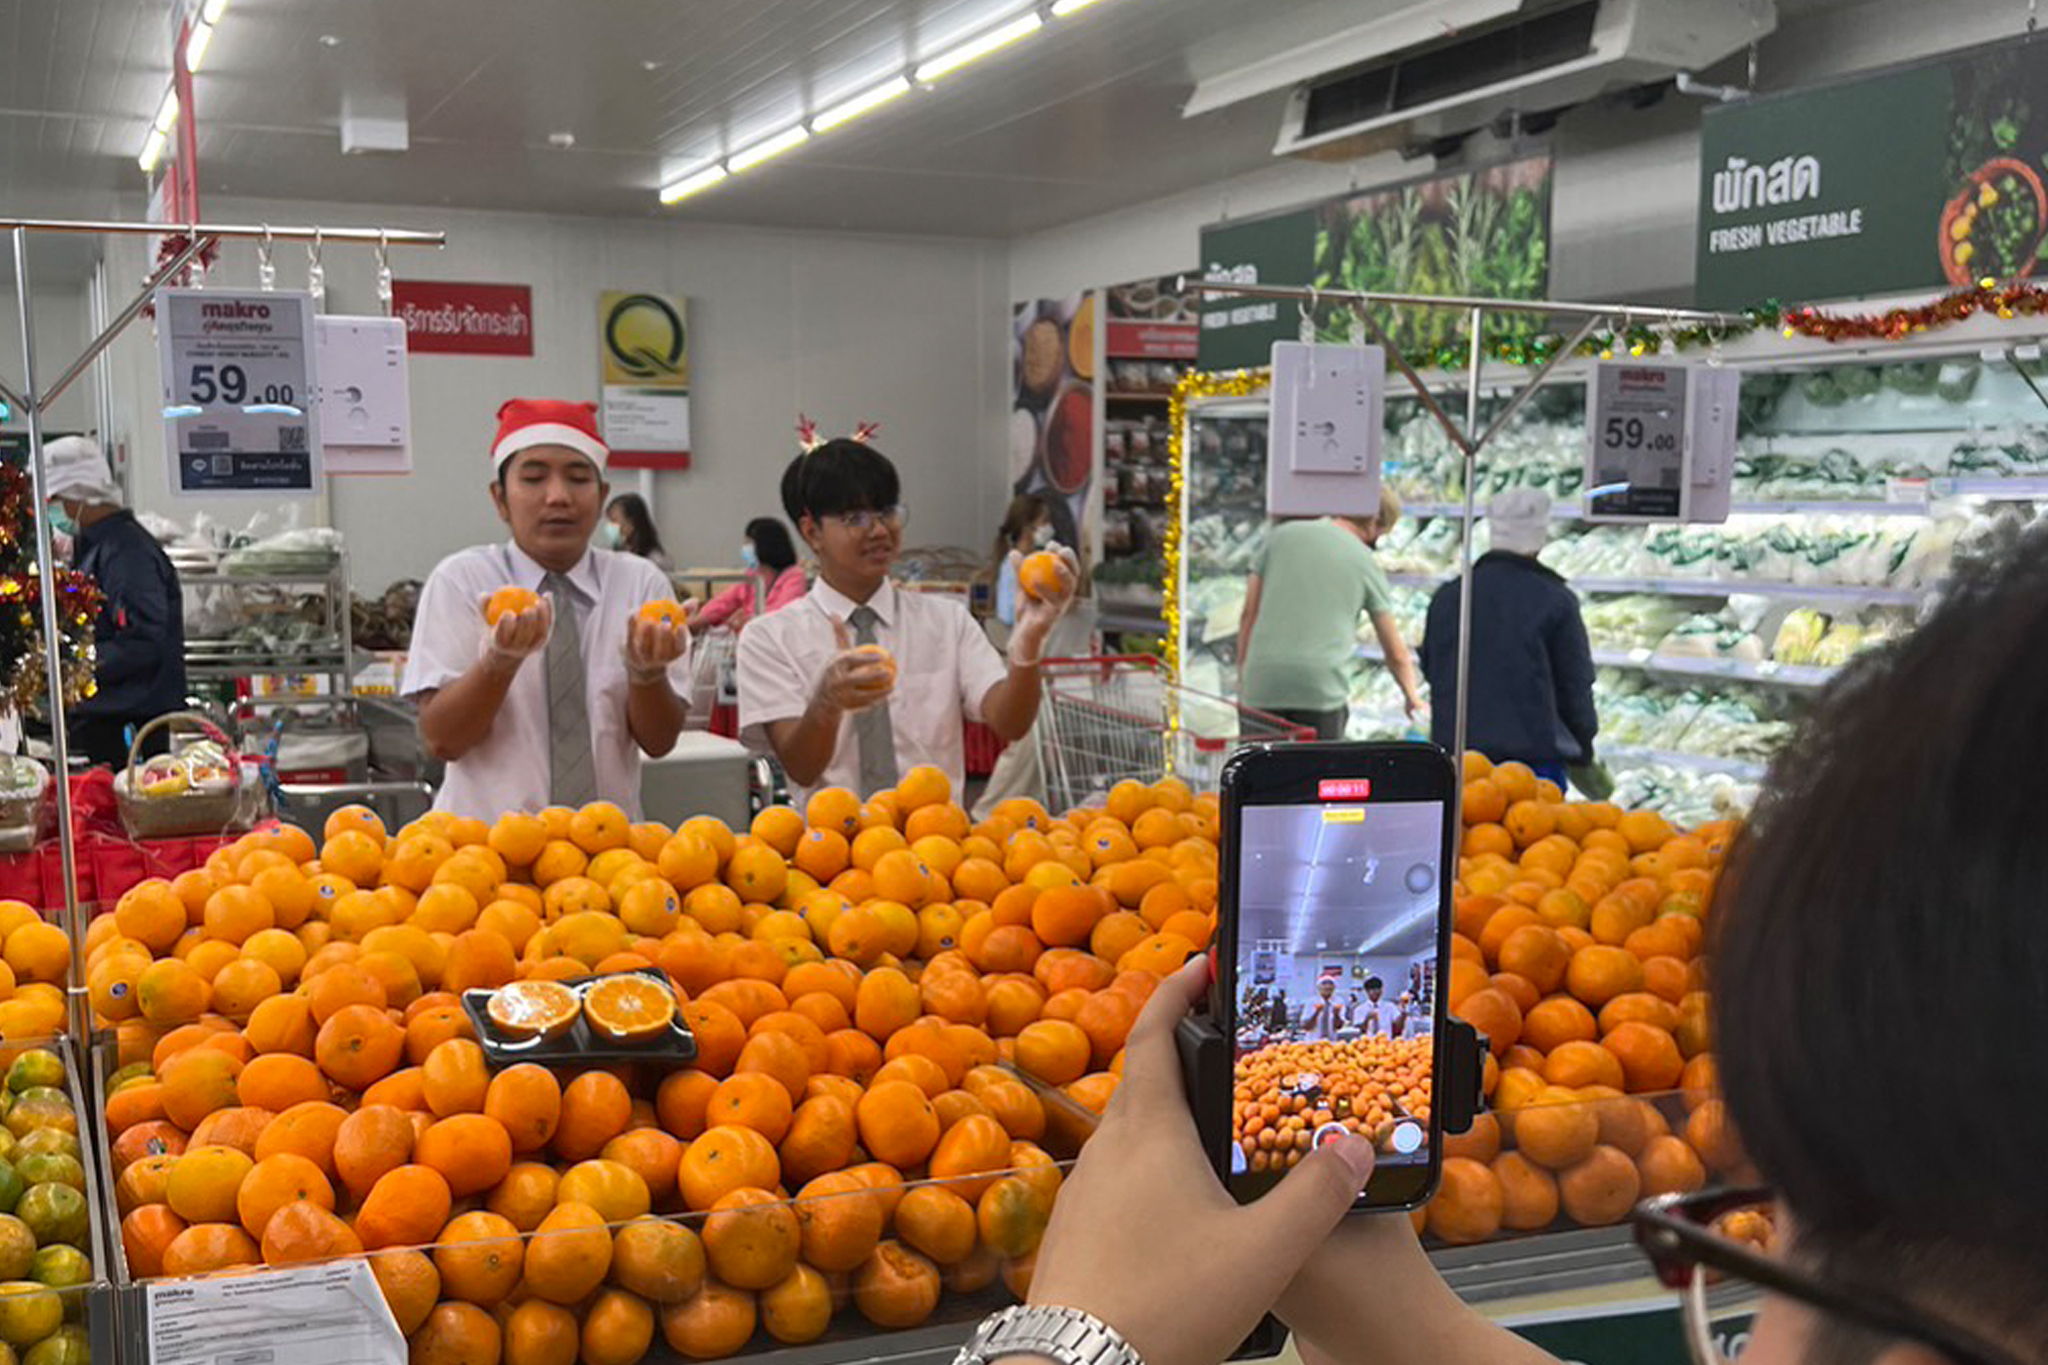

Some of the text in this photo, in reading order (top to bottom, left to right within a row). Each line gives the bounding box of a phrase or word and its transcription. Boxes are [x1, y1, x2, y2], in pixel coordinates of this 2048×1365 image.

[1711, 154, 1821, 214] ผักสด
[1709, 208, 1863, 254] FRESH VEGETABLE
[202, 301, 271, 318] makro
[190, 364, 294, 405] 59.00
[1604, 416, 1676, 451] 59.00
